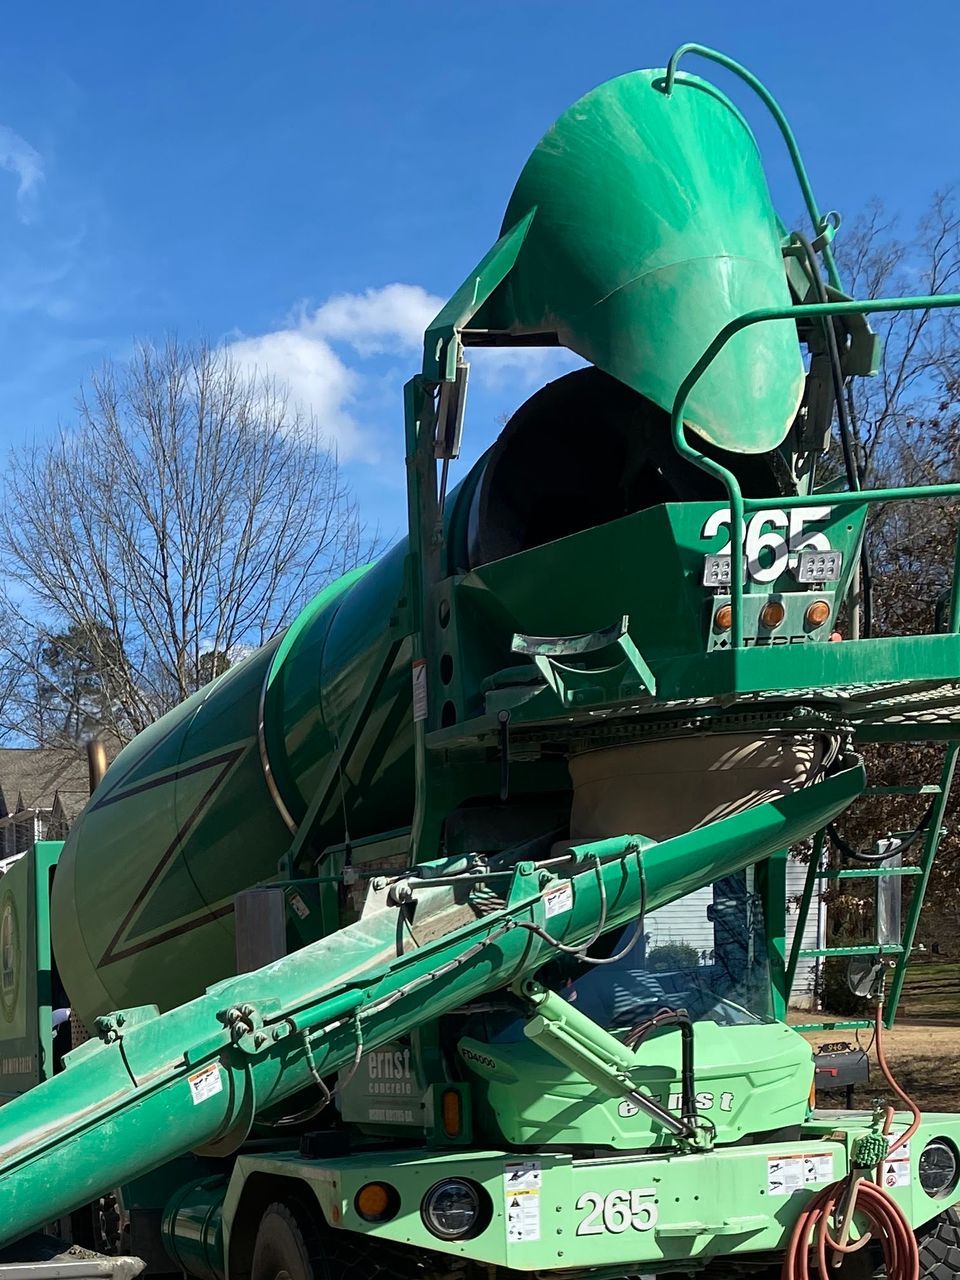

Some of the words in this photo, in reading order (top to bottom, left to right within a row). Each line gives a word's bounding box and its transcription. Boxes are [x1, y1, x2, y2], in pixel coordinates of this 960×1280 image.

[701, 506, 832, 584] 265
[368, 1049, 412, 1079] ernst
[461, 1048, 496, 1069] FD4000
[368, 1082, 412, 1095] concrete
[618, 1091, 734, 1118] enst
[575, 1187, 659, 1236] 265
